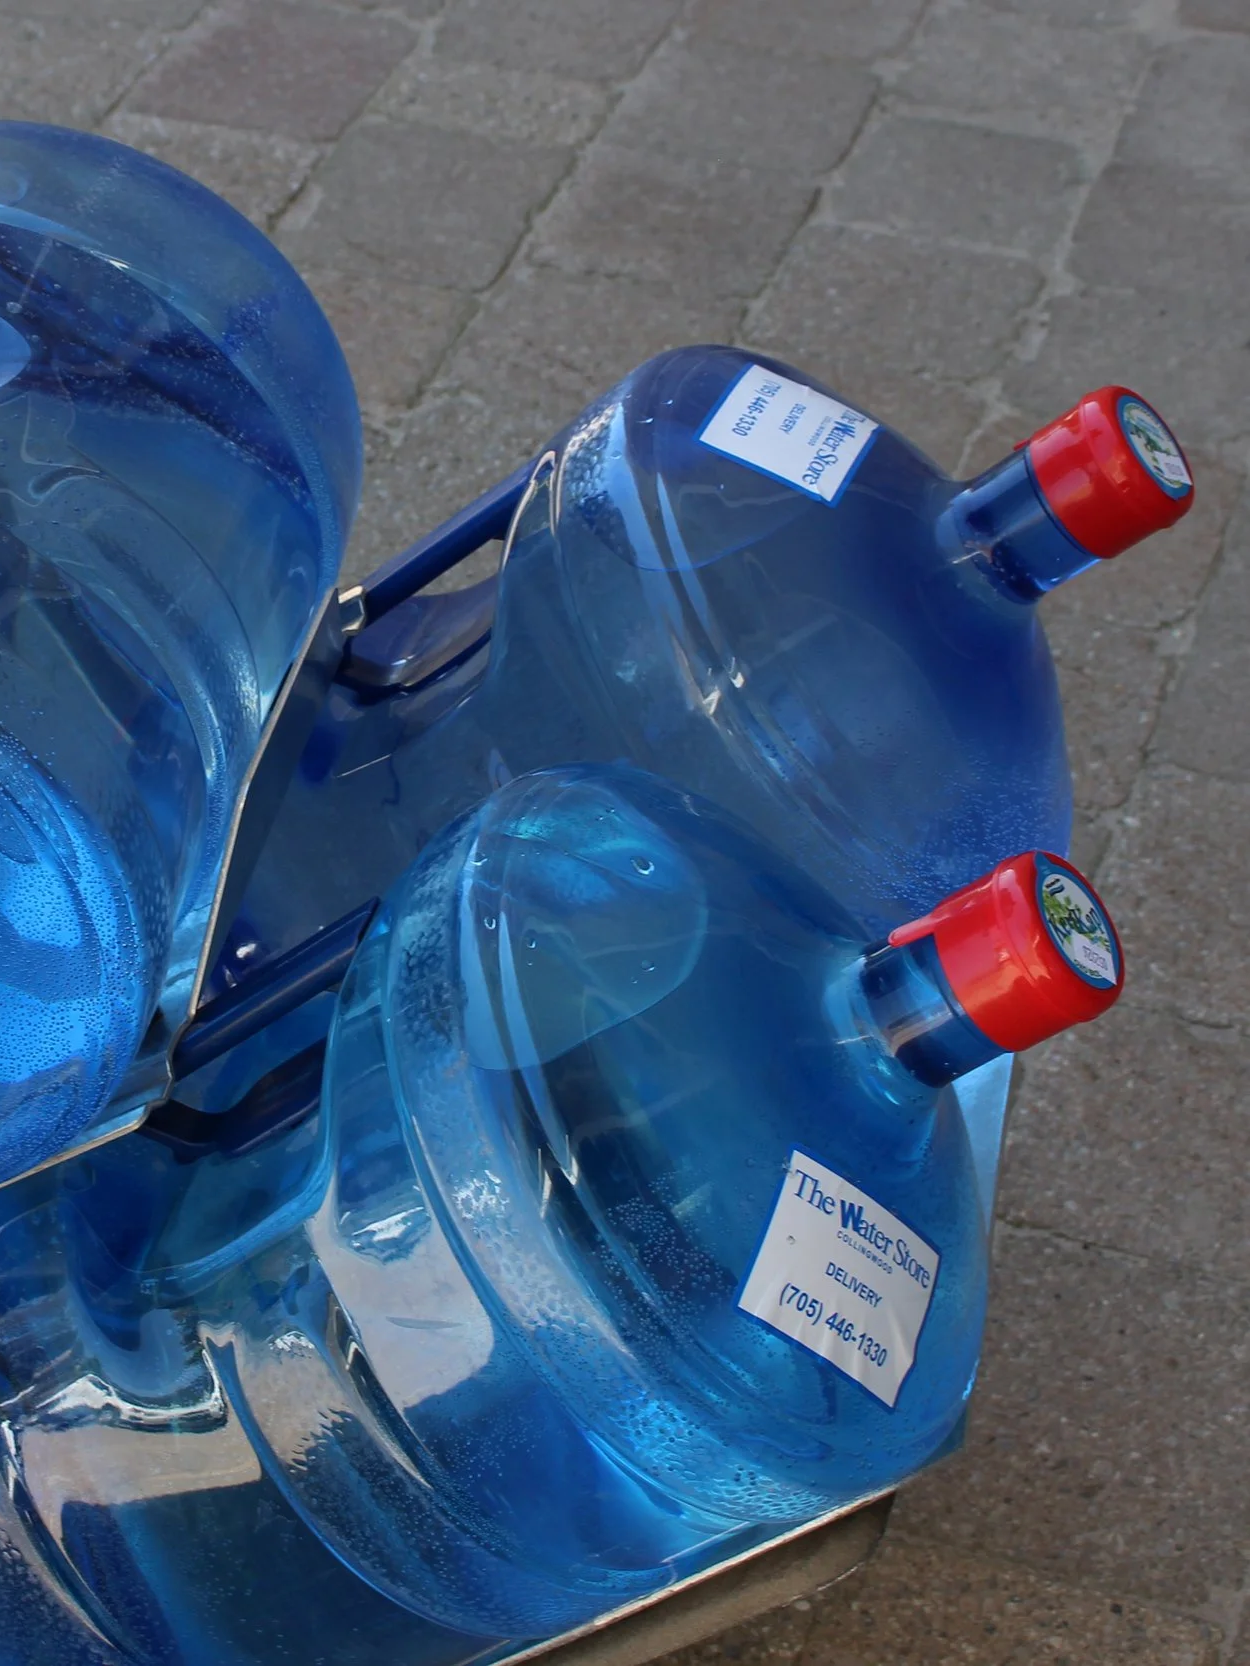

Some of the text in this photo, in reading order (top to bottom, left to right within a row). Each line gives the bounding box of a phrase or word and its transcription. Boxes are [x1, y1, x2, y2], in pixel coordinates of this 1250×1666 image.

[732, 379, 781, 437] (705) 446-1330
[778, 403, 806, 435] DELIVERY
[802, 409, 867, 486] The Water Store
[794, 1168, 930, 1289] The Water Store
[836, 1231, 893, 1275] COLLINGWOOD
[826, 1262, 883, 1308] DELIVERY
[778, 1282, 888, 1367] (705) 446-1330
